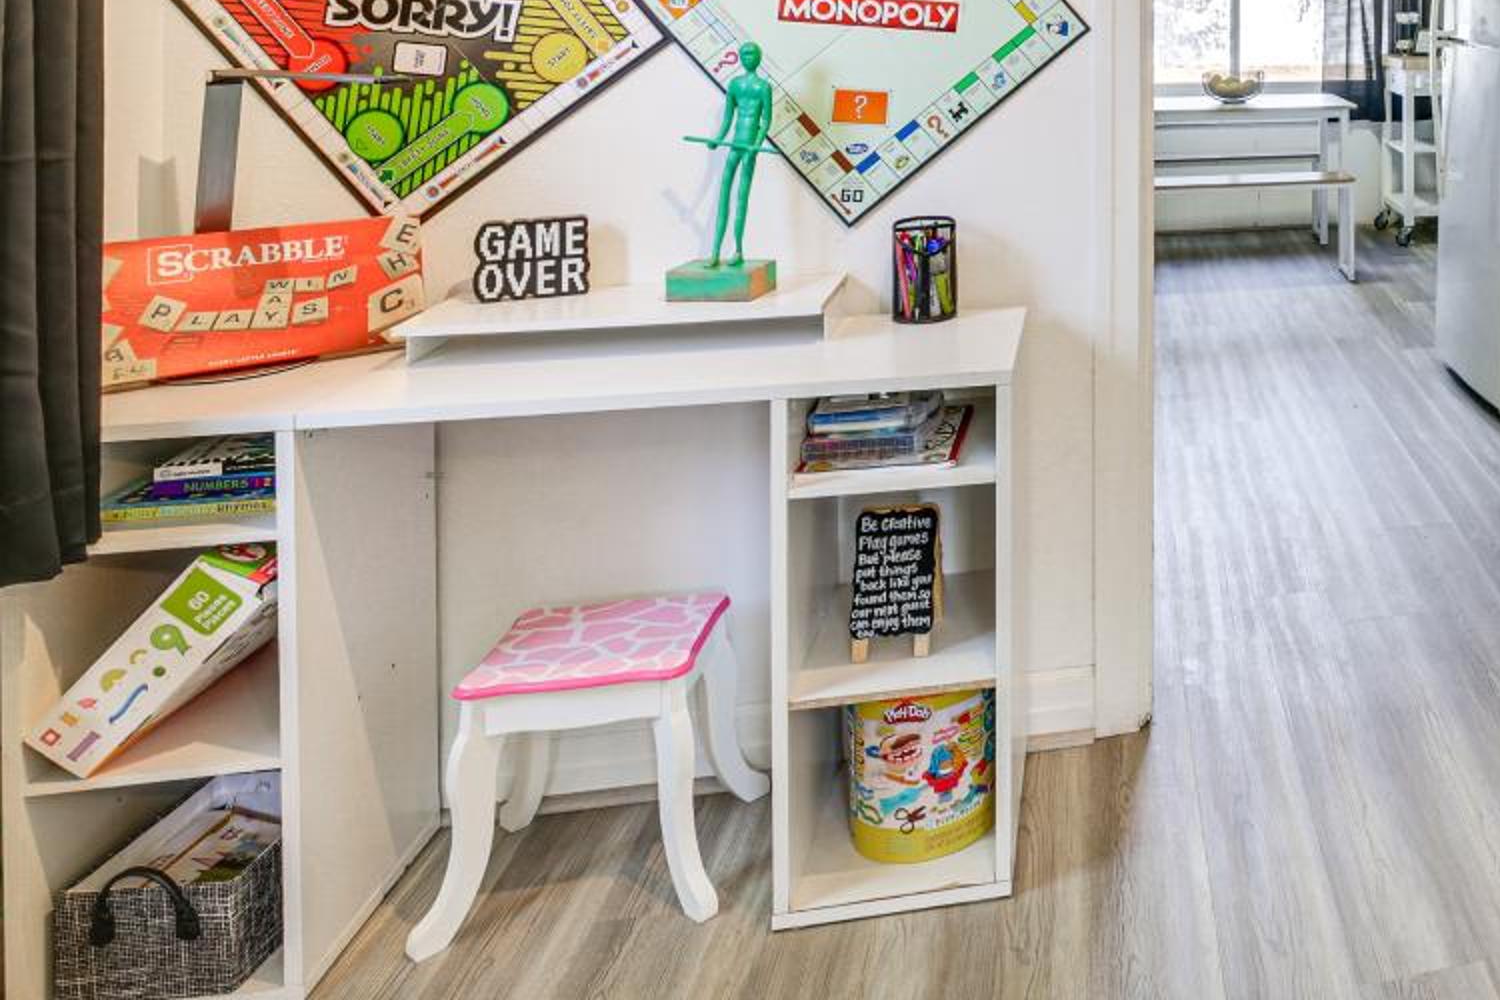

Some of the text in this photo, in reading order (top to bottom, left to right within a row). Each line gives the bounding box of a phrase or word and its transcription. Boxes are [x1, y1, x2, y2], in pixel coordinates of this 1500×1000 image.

[841, 188, 865, 203] GO
[479, 220, 585, 261] GAME
[157, 236, 346, 278] SCRABBLE
[479, 257, 586, 299] OVER
[183, 479, 250, 493] NUMBERS
[861, 516, 879, 533] Be
[889, 530, 930, 552] games
[882, 548, 923, 566] please
[855, 561, 919, 584] put things
[854, 591, 887, 607] found
[871, 616, 900, 633] enjoy
[901, 613, 931, 629] them
